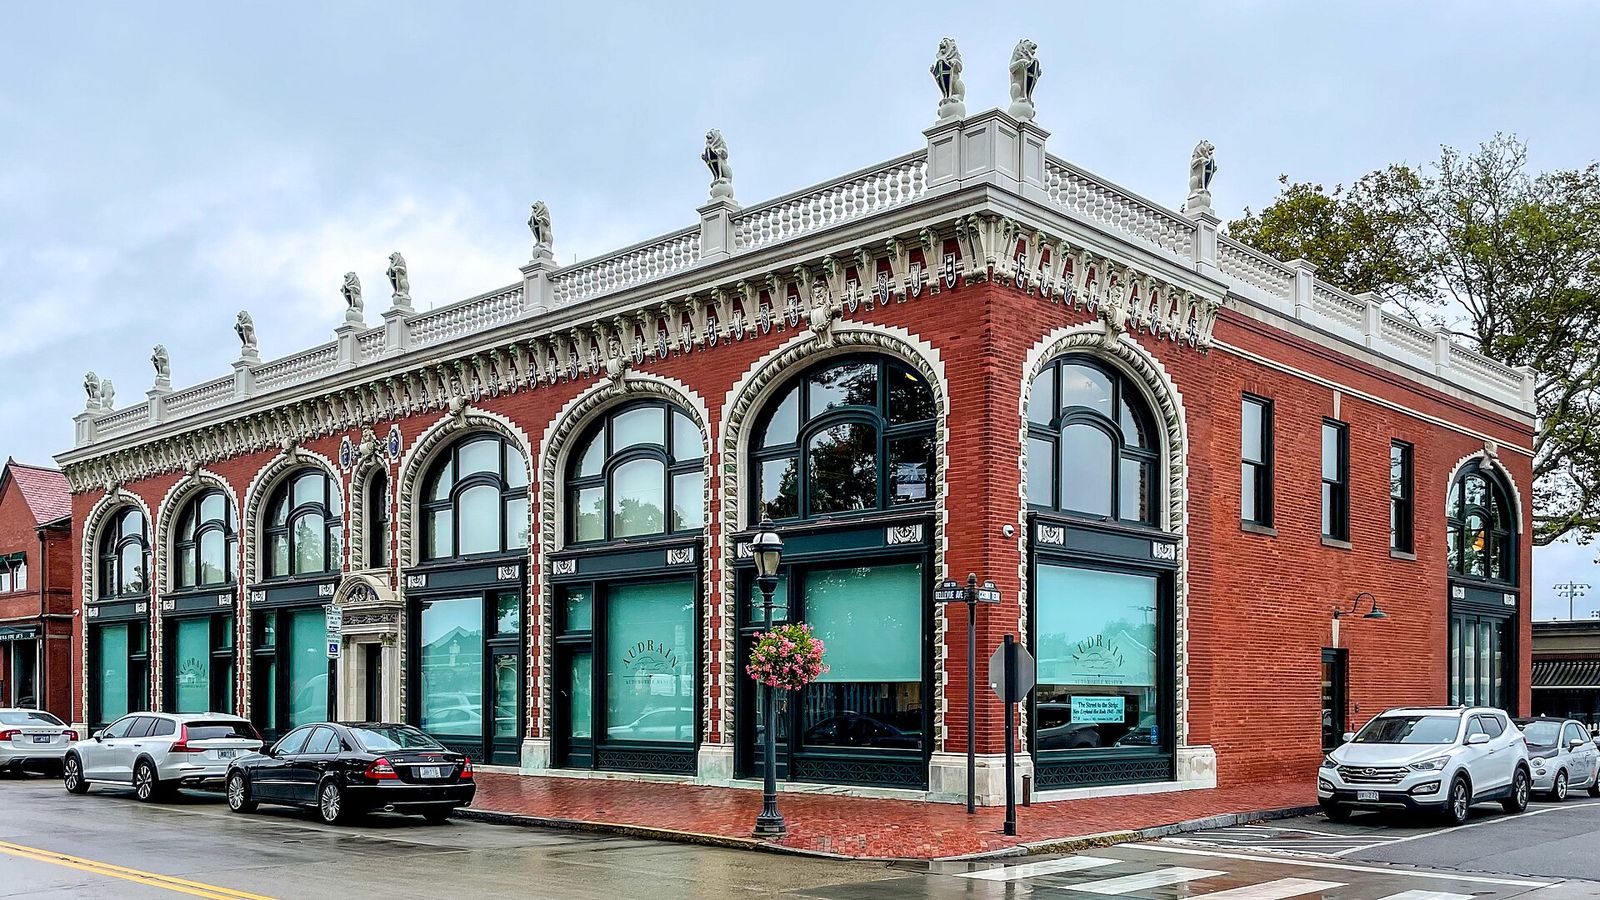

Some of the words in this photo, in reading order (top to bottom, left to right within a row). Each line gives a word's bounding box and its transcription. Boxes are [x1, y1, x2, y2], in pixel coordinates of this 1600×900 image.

[935, 590, 954, 600] BELLEVUE
[955, 590, 964, 599] AVE
[326, 606, 332, 614] 2
[623, 639, 679, 669] AUDRAIN
[1072, 634, 1126, 667] AUDRAIN
